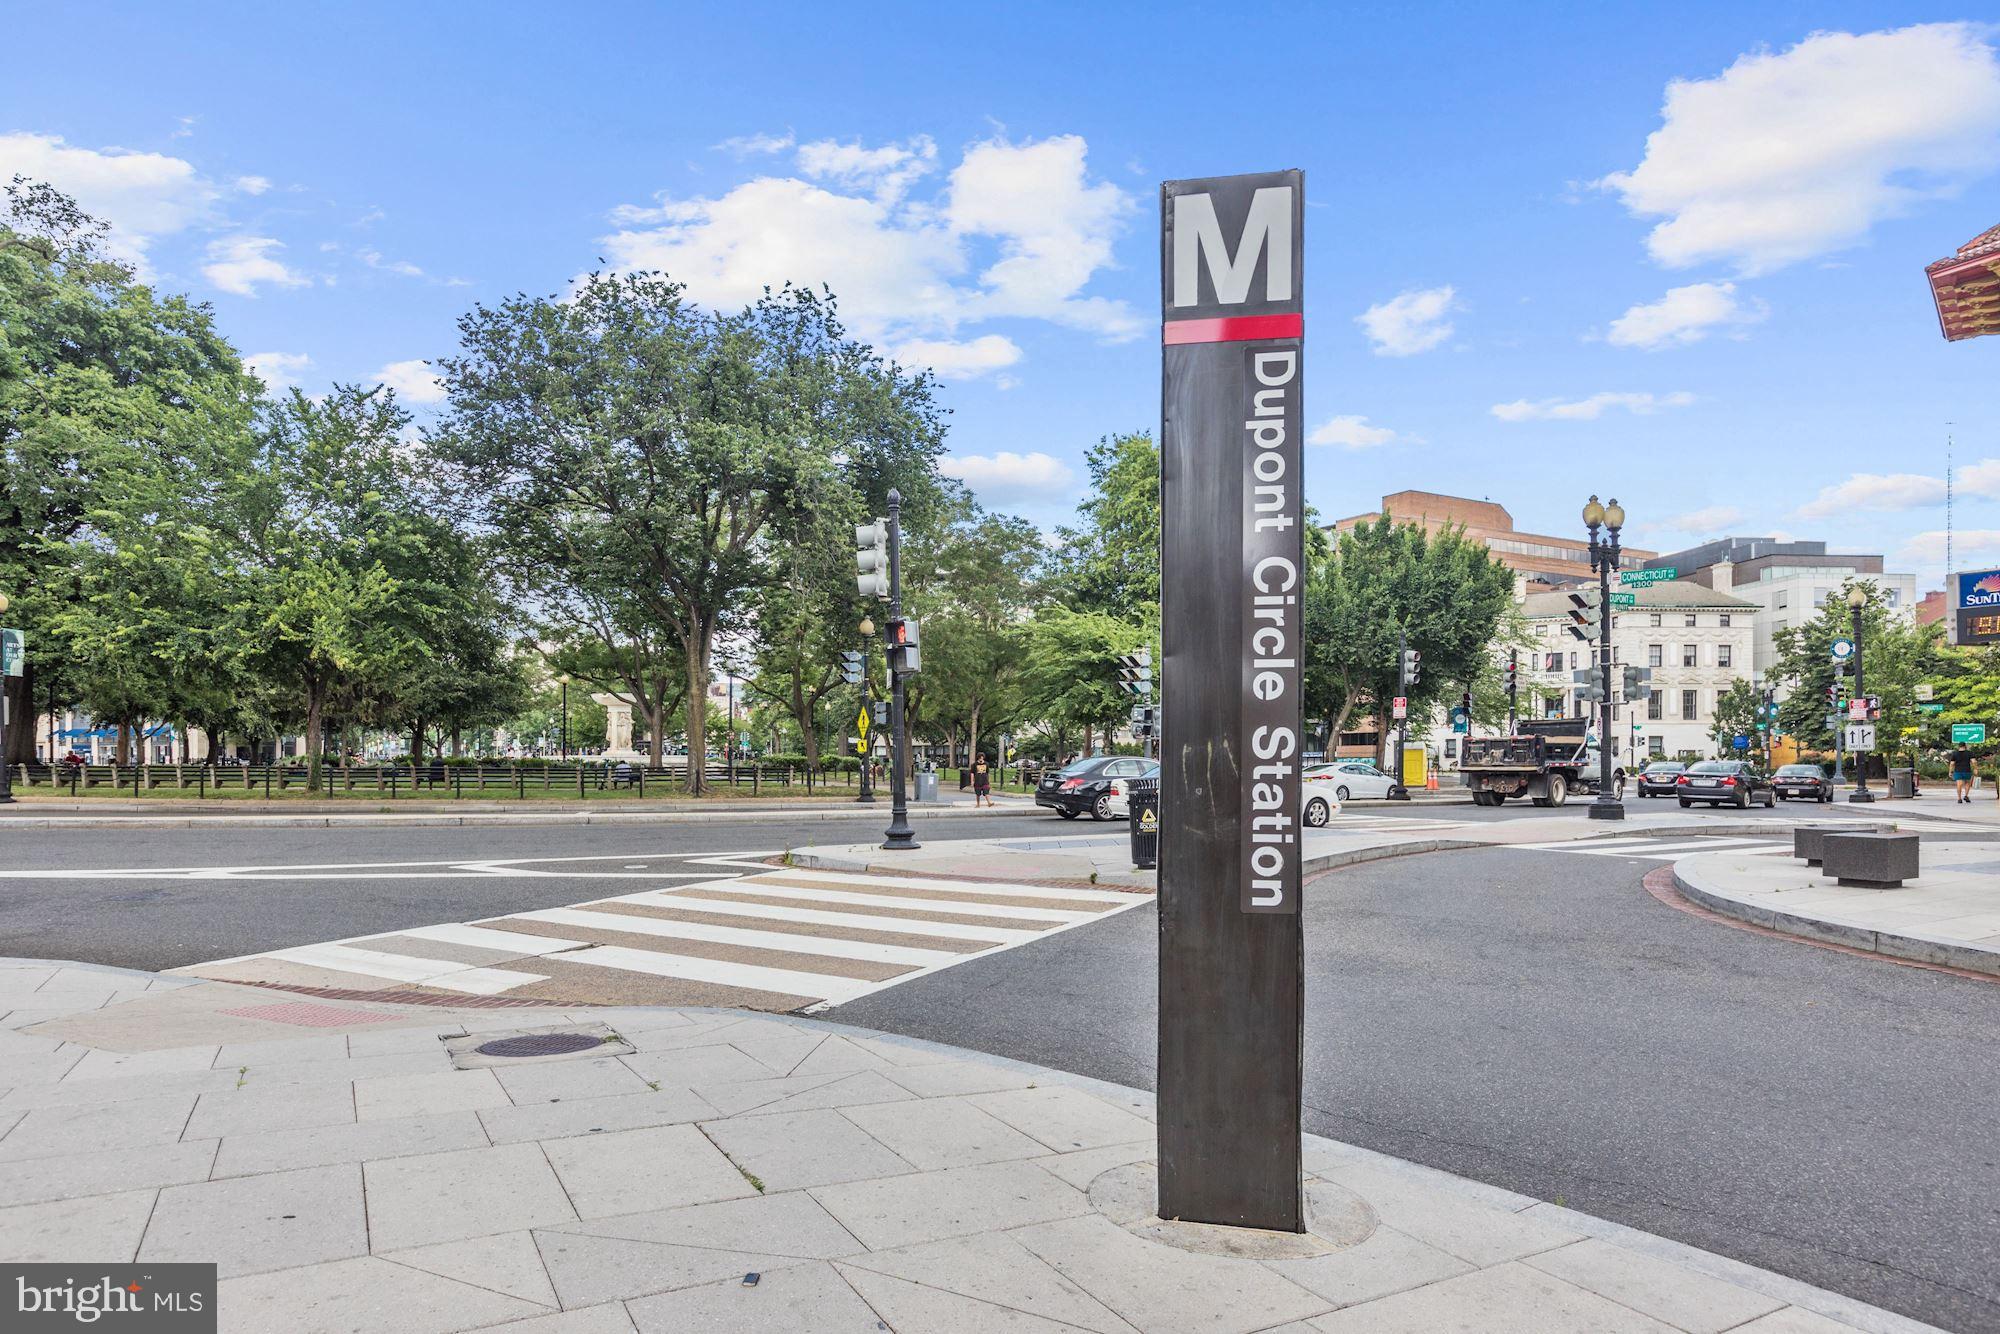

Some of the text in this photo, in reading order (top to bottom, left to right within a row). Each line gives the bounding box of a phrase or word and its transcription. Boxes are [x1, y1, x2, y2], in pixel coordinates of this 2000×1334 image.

[1173, 186, 1292, 308] M
[1622, 570, 1667, 582] CONNECTICUT
[1609, 594, 1629, 604] DUPONT
[1966, 592, 2000, 606] SUNT
[1245, 350, 1297, 908] Dupont Circle Station
